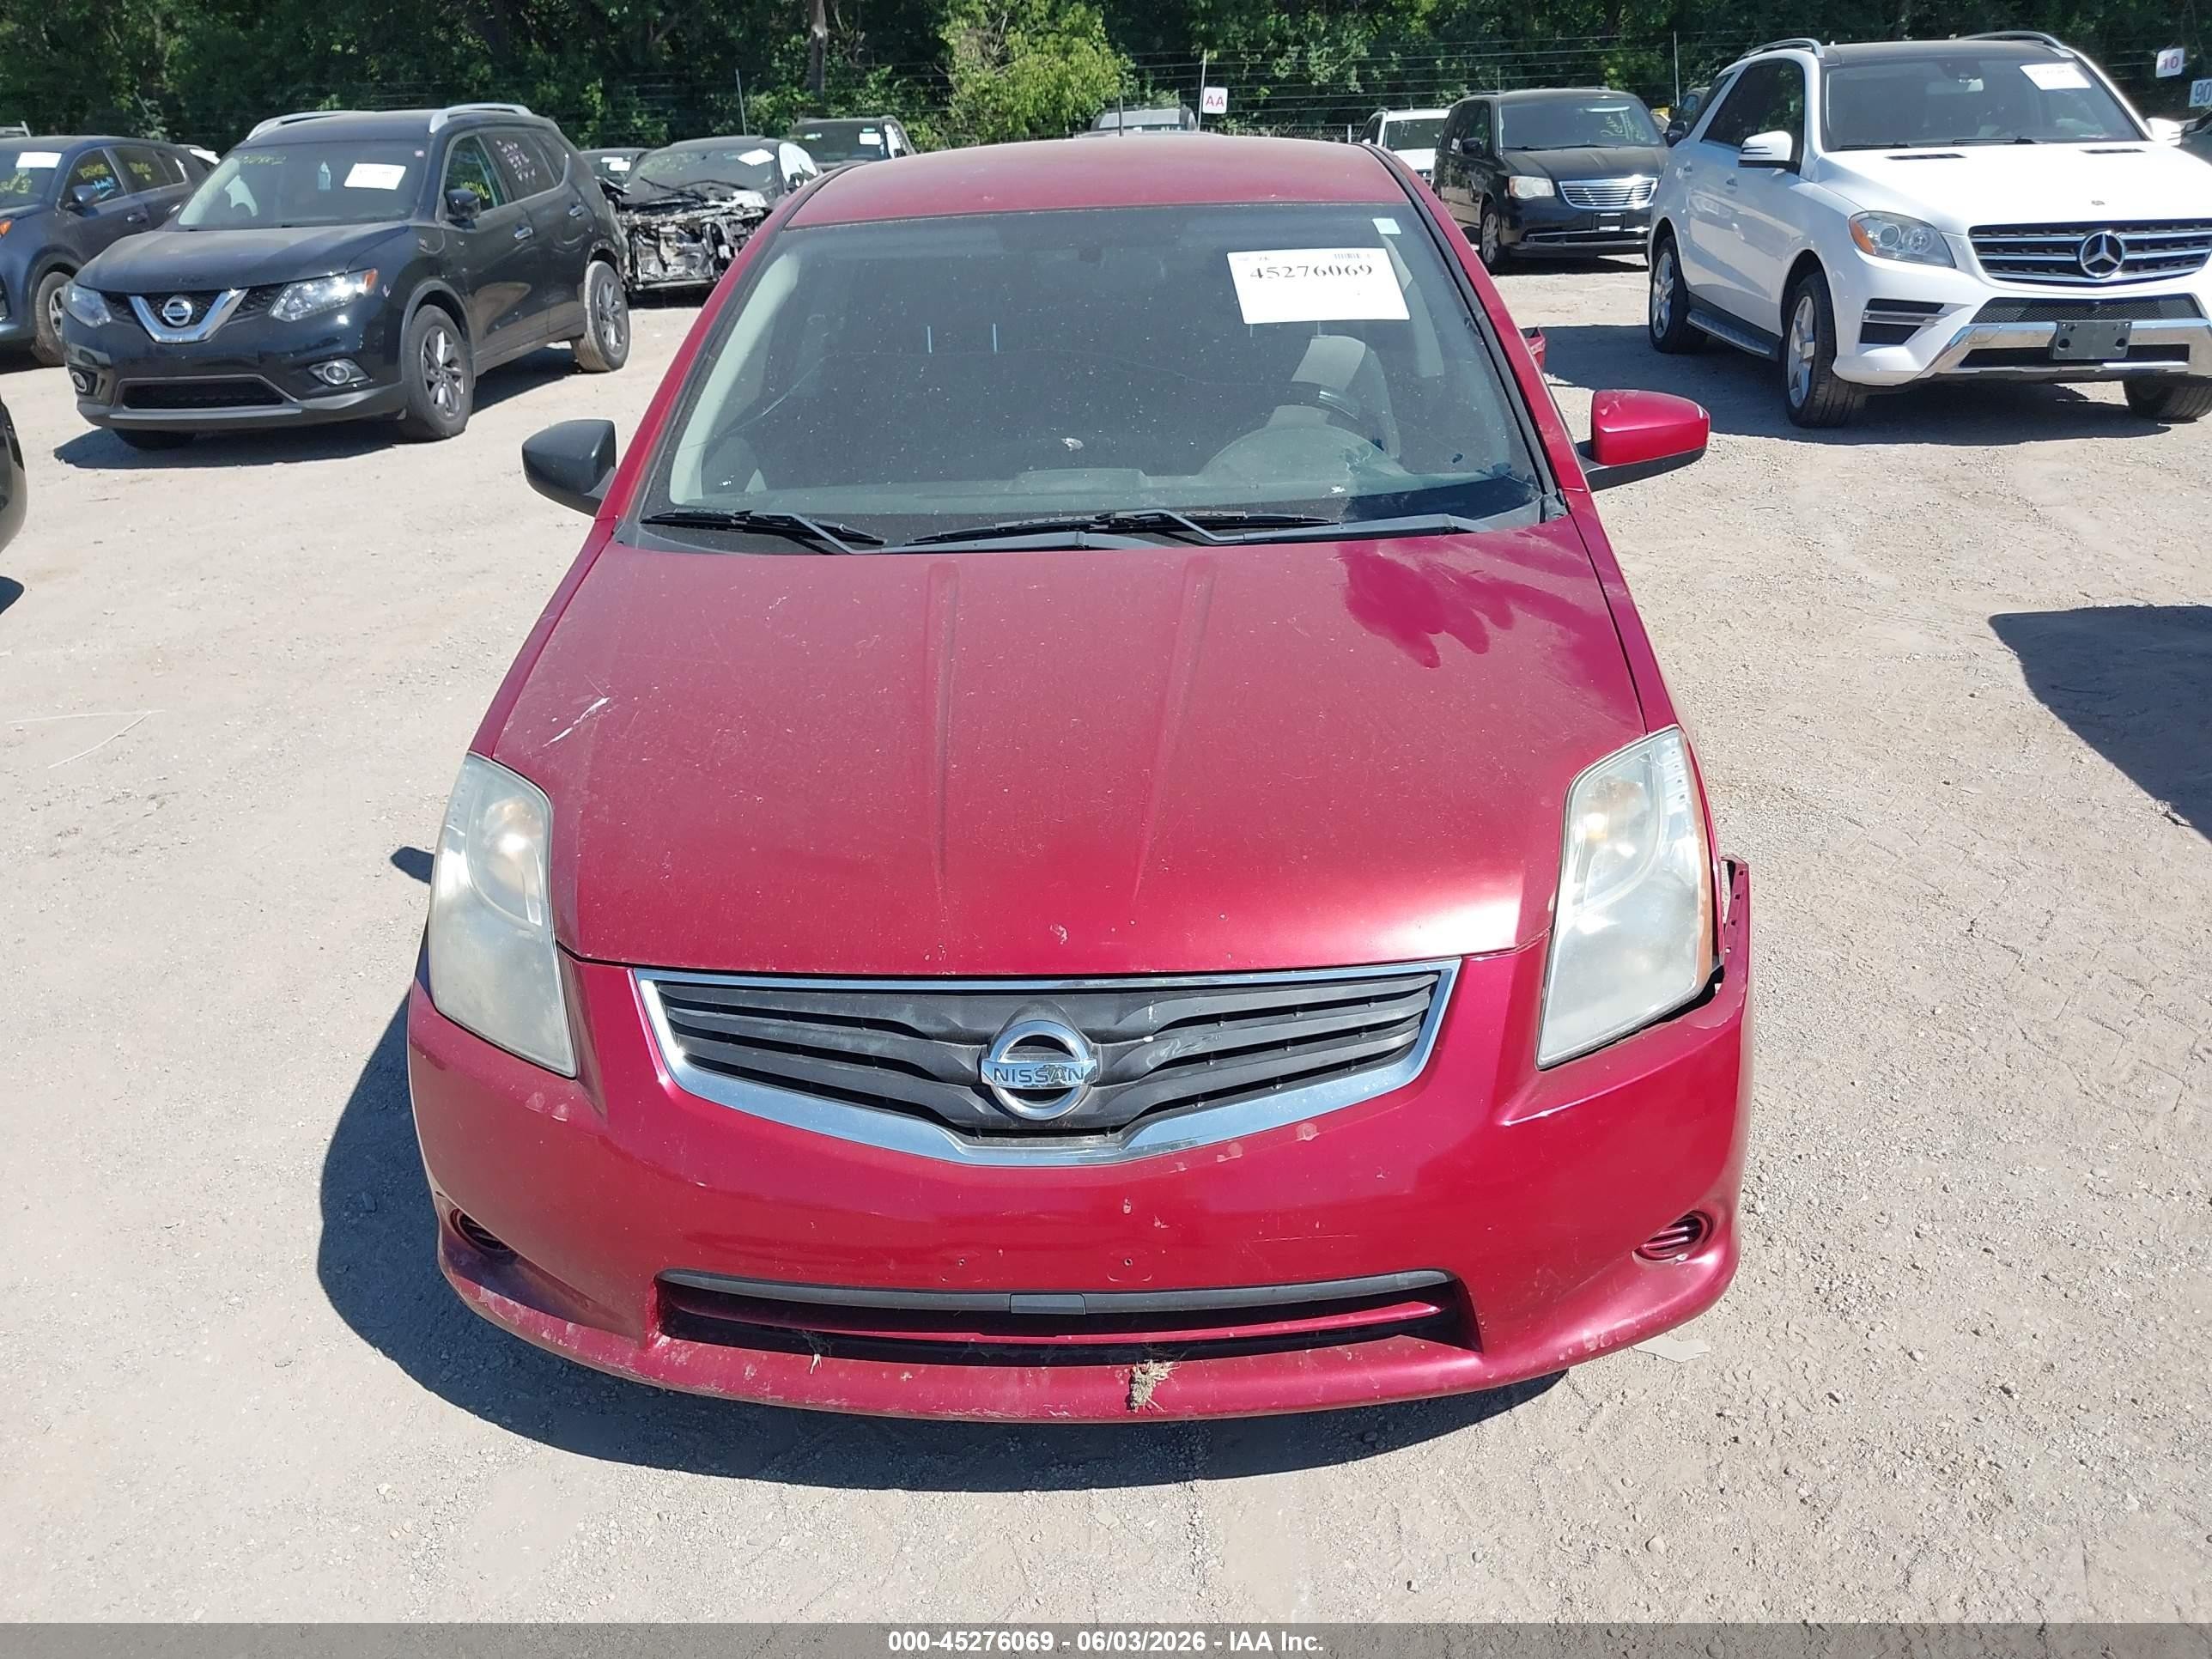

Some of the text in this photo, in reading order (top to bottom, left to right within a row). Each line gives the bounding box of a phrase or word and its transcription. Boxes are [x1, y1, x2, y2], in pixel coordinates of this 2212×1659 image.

[2162, 56, 2179, 70] 10
[1205, 95, 1224, 107] AA
[1249, 264, 1373, 279] 45276069
[994, 1066, 1085, 1083] NISSAN
